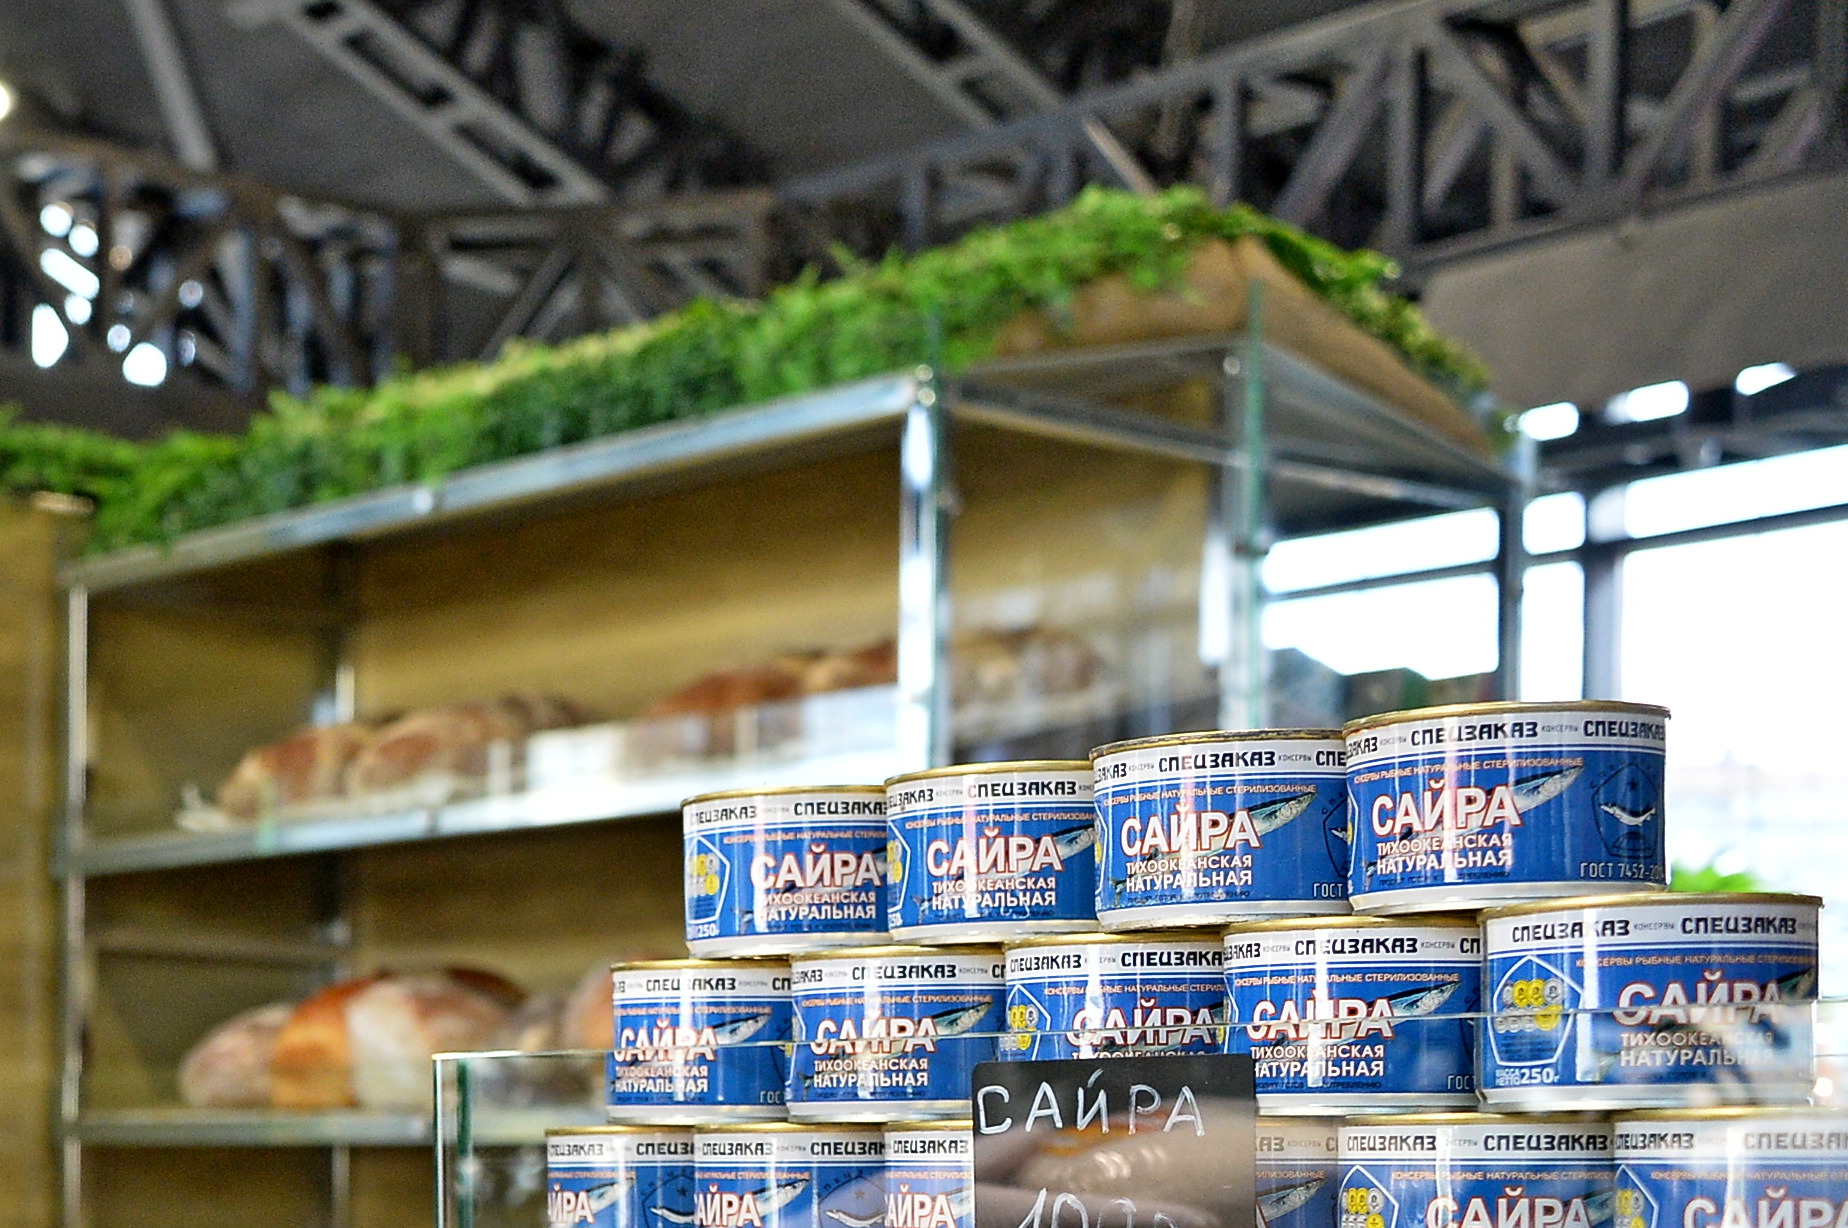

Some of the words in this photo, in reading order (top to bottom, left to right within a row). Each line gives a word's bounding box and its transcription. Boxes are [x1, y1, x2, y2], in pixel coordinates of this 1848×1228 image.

[1411, 721, 1538, 746] СПЕЦЗАКАЗ
[1158, 751, 1276, 773] СПЕЦЗАКАЗ
[1483, 756, 1585, 769] СТЕРИЛИЗОВАННЫЕ
[968, 781, 1076, 798] СПЕЦЗАКАЗ
[1226, 784, 1317, 794] СТЕРИЛИЗОВАННЫЕ
[1371, 778, 1526, 837] САЙРА
[1120, 803, 1262, 857] САЙРА
[926, 826, 1065, 877] САЙРА
[750, 843, 883, 890] САЙРА
[1580, 863, 1614, 879] ГОСТ
[1126, 870, 1252, 893] НАТУРАЛЬНАЯ
[1313, 882, 1343, 898] ГОСТ
[761, 891, 876, 906] ИХООКЕАНСКАЯ
[932, 891, 1056, 911] НАТУРАЛЬНАЯ
[1513, 920, 1630, 942] СПЕЦЗААЗ
[1681, 916, 1797, 935] СПЕЦЗАКАЗ
[1120, 951, 1223, 967] СПЕЦЗАКА
[1635, 955, 1683, 965] РЫБНЫЕ
[1685, 954, 1755, 964] НАТУРАЛЬНЫЕ
[646, 978, 736, 992] СПЕЦАКАЗ
[1365, 972, 1459, 983] СТЕРИЛИЗОВАННЫЕ
[1125, 984, 1188, 993] НАТУРАЛЬНЫЕ
[1612, 968, 1782, 1026] САЙРА
[1066, 996, 1219, 1047] САЙРА
[614, 1018, 719, 1062] САЙРА
[810, 1008, 939, 1055] САЙРА
[814, 1072, 928, 1088] НАТУРАЛЬНАЯ
[1520, 1068, 1560, 1084] 250г
[760, 1091, 785, 1103] ГОС
[976, 1068, 1205, 1137] САЙРА
[637, 1143, 694, 1156] СПЕЦЗ
[811, 1141, 885, 1156] СПЕЦЗАК
[1347, 1135, 1437, 1152] СПЕЦЗАКАЗ
[1483, 1135, 1609, 1152] СПЕЦЗАКАЗ
[1744, 1132, 1848, 1150] СПЕЦЗА
[1486, 1171, 1560, 1181] НАТУРАЛЬНЫЕ
[548, 1182, 595, 1224] ЙРА
[695, 1184, 764, 1228] АЙРА
